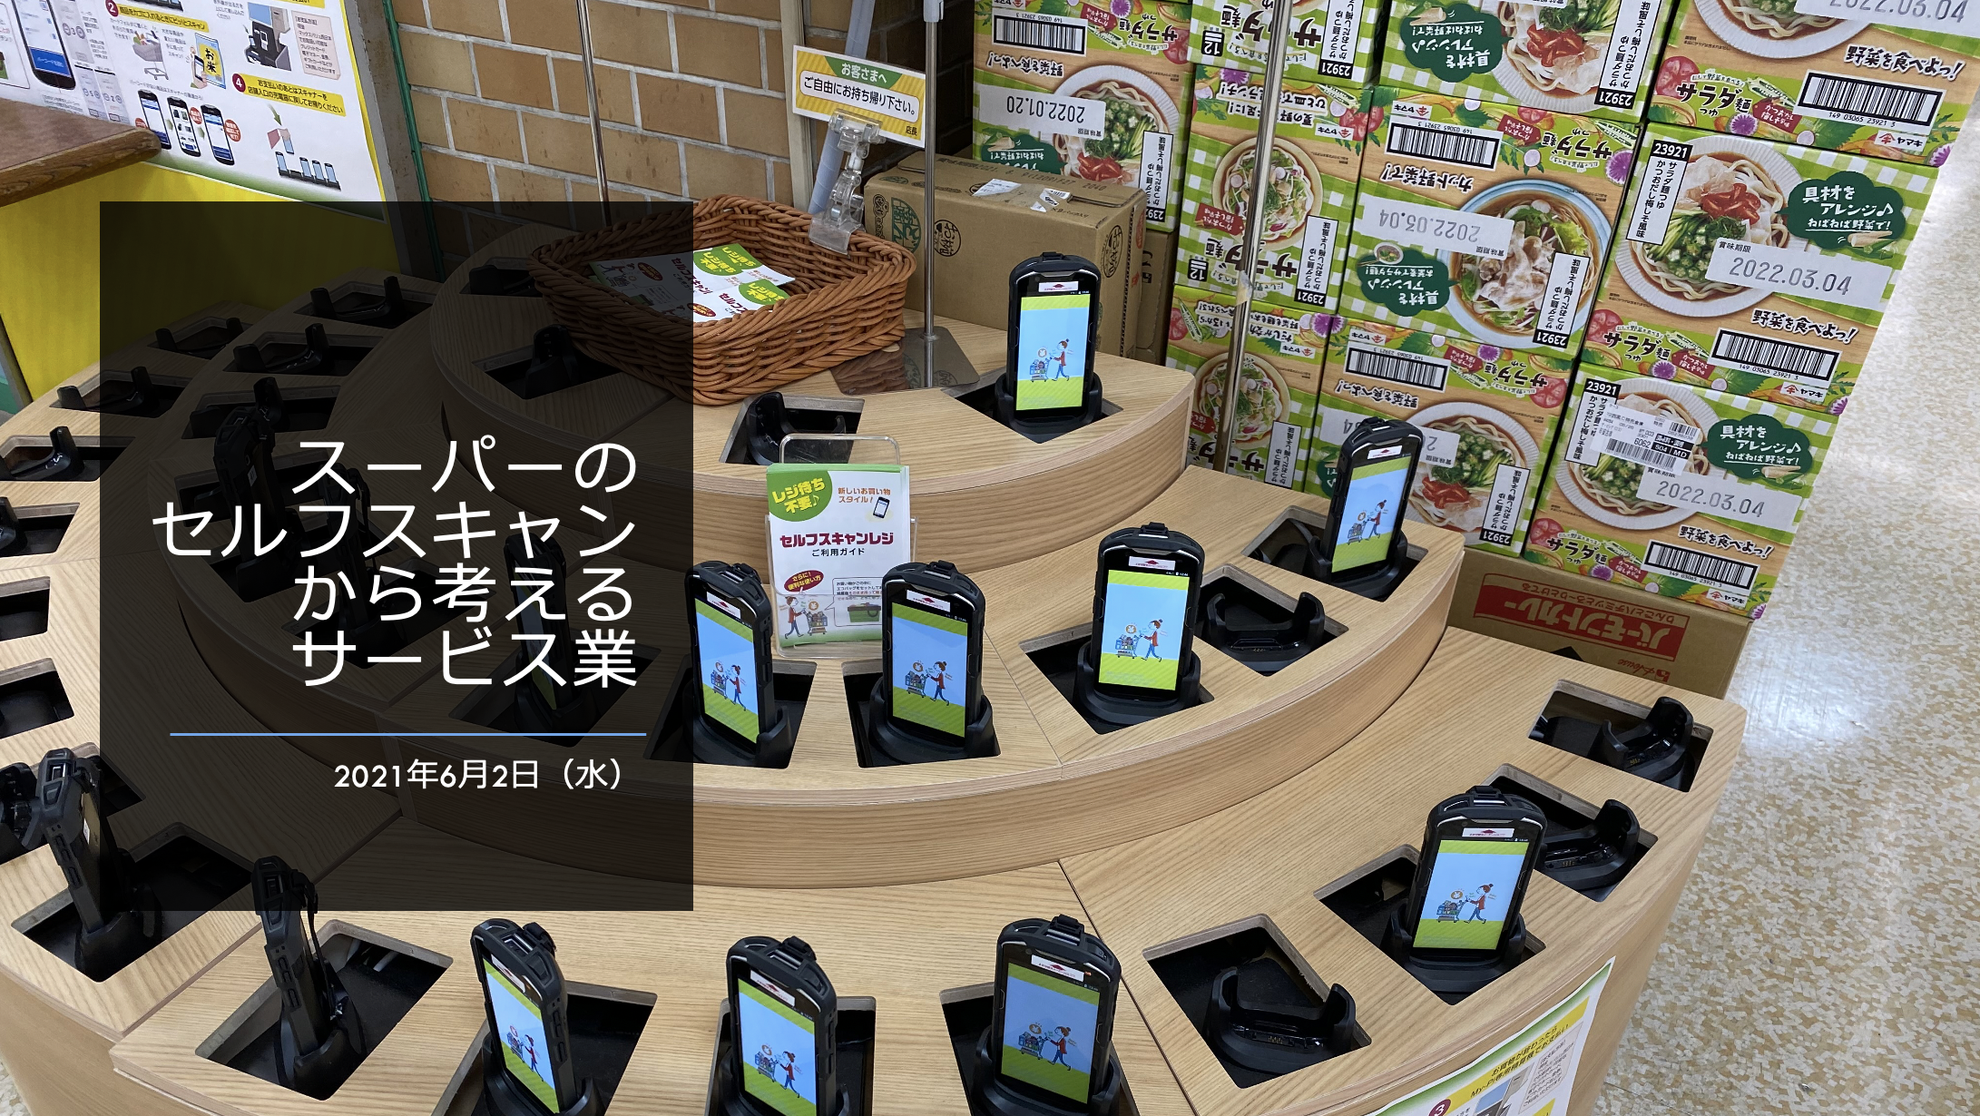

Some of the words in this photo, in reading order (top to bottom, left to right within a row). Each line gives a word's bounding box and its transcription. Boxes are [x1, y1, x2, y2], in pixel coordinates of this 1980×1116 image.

[1118, 18, 1178, 42] サラダ麺
[1220, 6, 1322, 48] サダ麺
[1328, 11, 1343, 58] サラダ麺つゆ
[1412, 24, 1484, 36] ねばねば野菜で!
[1204, 42, 1220, 55] 12
[1622, 0, 1649, 88] かつおだし梅しそ風味
[205, 48, 217, 73] お米
[986, 52, 1064, 78] 野菜を食べよっ!
[1321, 62, 1351, 76] 23921
[1446, 51, 1490, 69] 具材を
[1608, 36, 1629, 88] サラダ麺つゆ
[1846, 44, 1966, 81] 野菜を食べよっ!
[841, 62, 887, 84] お客さまへ
[236, 78, 242, 88] 4
[804, 76, 915, 116] ご自由にお持ち帰り下さい。
[1220, 81, 1326, 108] ひと皿でランチ!
[1595, 90, 1634, 106] 23921
[1676, 82, 1752, 114] サラダ麺
[1007, 95, 1085, 124] 2022.01.20
[1229, 102, 1312, 126] 夏の野足に!
[1394, 104, 1416, 112] ヤマキ
[1700, 106, 1719, 118] つゆ
[1764, 104, 1795, 123] かつおだし
[1828, 111, 1840, 119] 149
[1843, 113, 1865, 123] 03065
[1866, 117, 1888, 127] 23921
[906, 125, 917, 136] 店長
[1077, 128, 1102, 137] 賞味期限
[1318, 126, 1338, 135] ヤマキ
[1572, 128, 1590, 136] つゆ
[1541, 131, 1612, 161] サラダ麺
[1654, 142, 1688, 159] 23921
[1895, 136, 1924, 148] ヤマキ
[1380, 164, 1473, 192] カット野菜で!
[1656, 160, 1678, 210] サラダ麺つゆ
[1635, 159, 1666, 238] かつおだし梅しそ風味
[1802, 185, 1854, 204] 具材を
[1378, 209, 1480, 243] 2022.03.04
[1807, 218, 1892, 231] ねばねば野菜で!
[722, 246, 757, 267] レジ待ち
[1313, 222, 1330, 290] かつおだし梅しそ風味
[1476, 246, 1505, 257] 賞味期限
[1718, 240, 1752, 254] 賞味期限
[704, 252, 737, 274] レジ待ち
[1304, 248, 1316, 290] サラダ麺つゆ
[1190, 268, 1206, 280] 12
[1728, 256, 1852, 296] 2022.03.04
[1297, 291, 1324, 305] 23921
[1398, 291, 1439, 306] 具材を
[1556, 259, 1582, 332] かつおだし梅しそ風味
[1545, 286, 1562, 330] サラダ麺つゆ
[1750, 308, 1859, 344] 野菜を食べよっ!
[1351, 332, 1370, 341] ヤマキ
[1535, 332, 1568, 347] 23921
[1282, 346, 1301, 354] ヤマキ
[1602, 332, 1672, 362] サラダ麺
[1510, 360, 1527, 369] つゆ
[1624, 353, 1642, 362] つゆ
[1484, 362, 1548, 388] サラダ麺
[1336, 380, 1418, 409] 野菜を食べよっ!
[1586, 381, 1617, 396] 23921
[1799, 388, 1824, 398] ヤマキ
[1572, 395, 1598, 461] かつおだし梅しそ風味
[1720, 426, 1766, 439] 具材を
[1425, 454, 1452, 466] 賞味期限
[1725, 451, 1800, 465] ねばねば野菜で!
[772, 478, 826, 504] レジ待ち
[838, 487, 891, 496] 新しいお買い物
[1499, 469, 1523, 532] かつおだし梅しそ風味
[1656, 480, 1765, 518] 2022.03.04
[1490, 493, 1506, 530] サラダ麺つゆ
[780, 532, 894, 548] セルフスキャンレジ
[1482, 531, 1510, 544] 23921
[1678, 524, 1776, 559] 野菜を食べよっ!
[812, 548, 865, 557] ご利用ガイド
[1546, 538, 1608, 566] サラダ麺
[1566, 556, 1582, 564] つゆ
[1723, 593, 1746, 604] ヤマキ
[1504, 597, 1670, 650] バーモントカレー
[1617, 658, 1656, 676] House
[1436, 1104, 1445, 1115] 3
